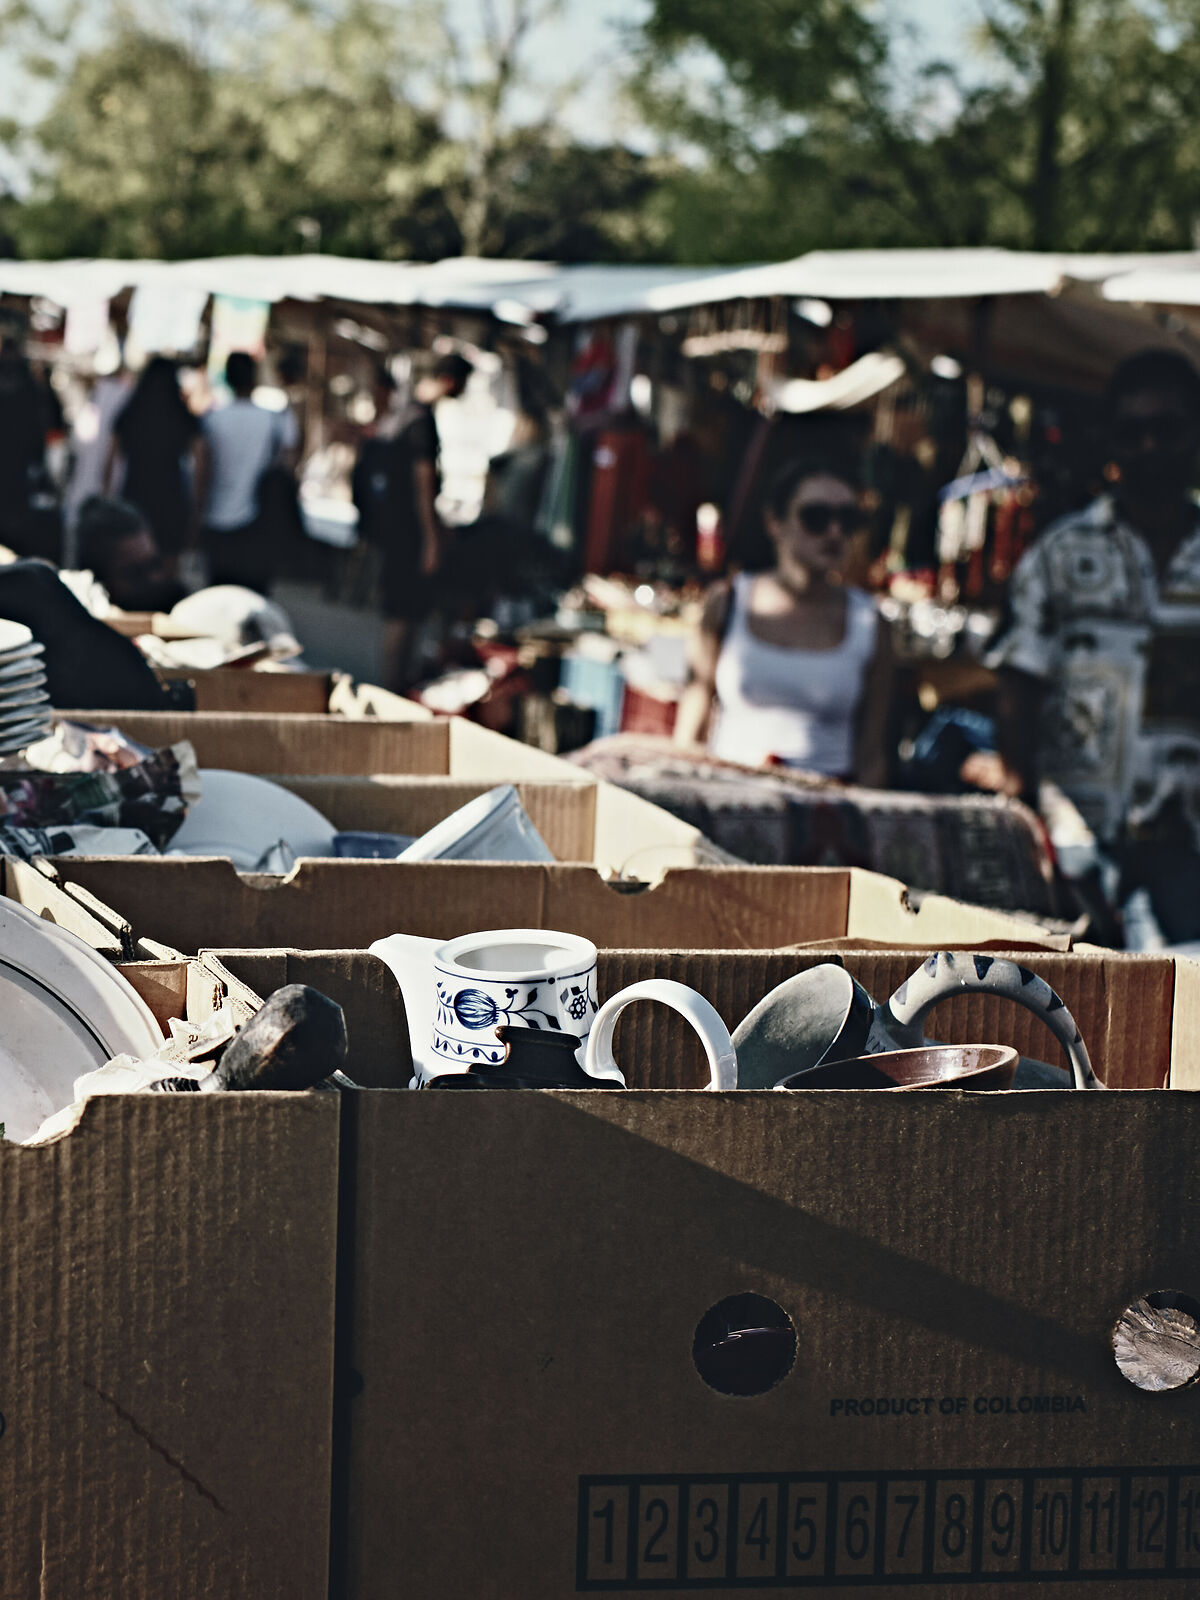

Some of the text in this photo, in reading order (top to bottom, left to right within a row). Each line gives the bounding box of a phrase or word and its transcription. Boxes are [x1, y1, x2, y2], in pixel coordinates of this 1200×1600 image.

[829, 1395, 1088, 1417] PRODUCT OF COLOMBIA
[593, 1499, 615, 1564] 1
[643, 1498, 669, 1563] 2
[694, 1498, 720, 1562] 3
[744, 1497, 771, 1561] 4
[792, 1497, 817, 1561] 5
[845, 1495, 870, 1560] 6
[895, 1495, 919, 1558] 7
[942, 1493, 966, 1558] 8
[991, 1492, 1015, 1557] 9
[1035, 1491, 1068, 1556] 10
[1085, 1491, 1116, 1554] 11
[1132, 1489, 1165, 1553] 12
